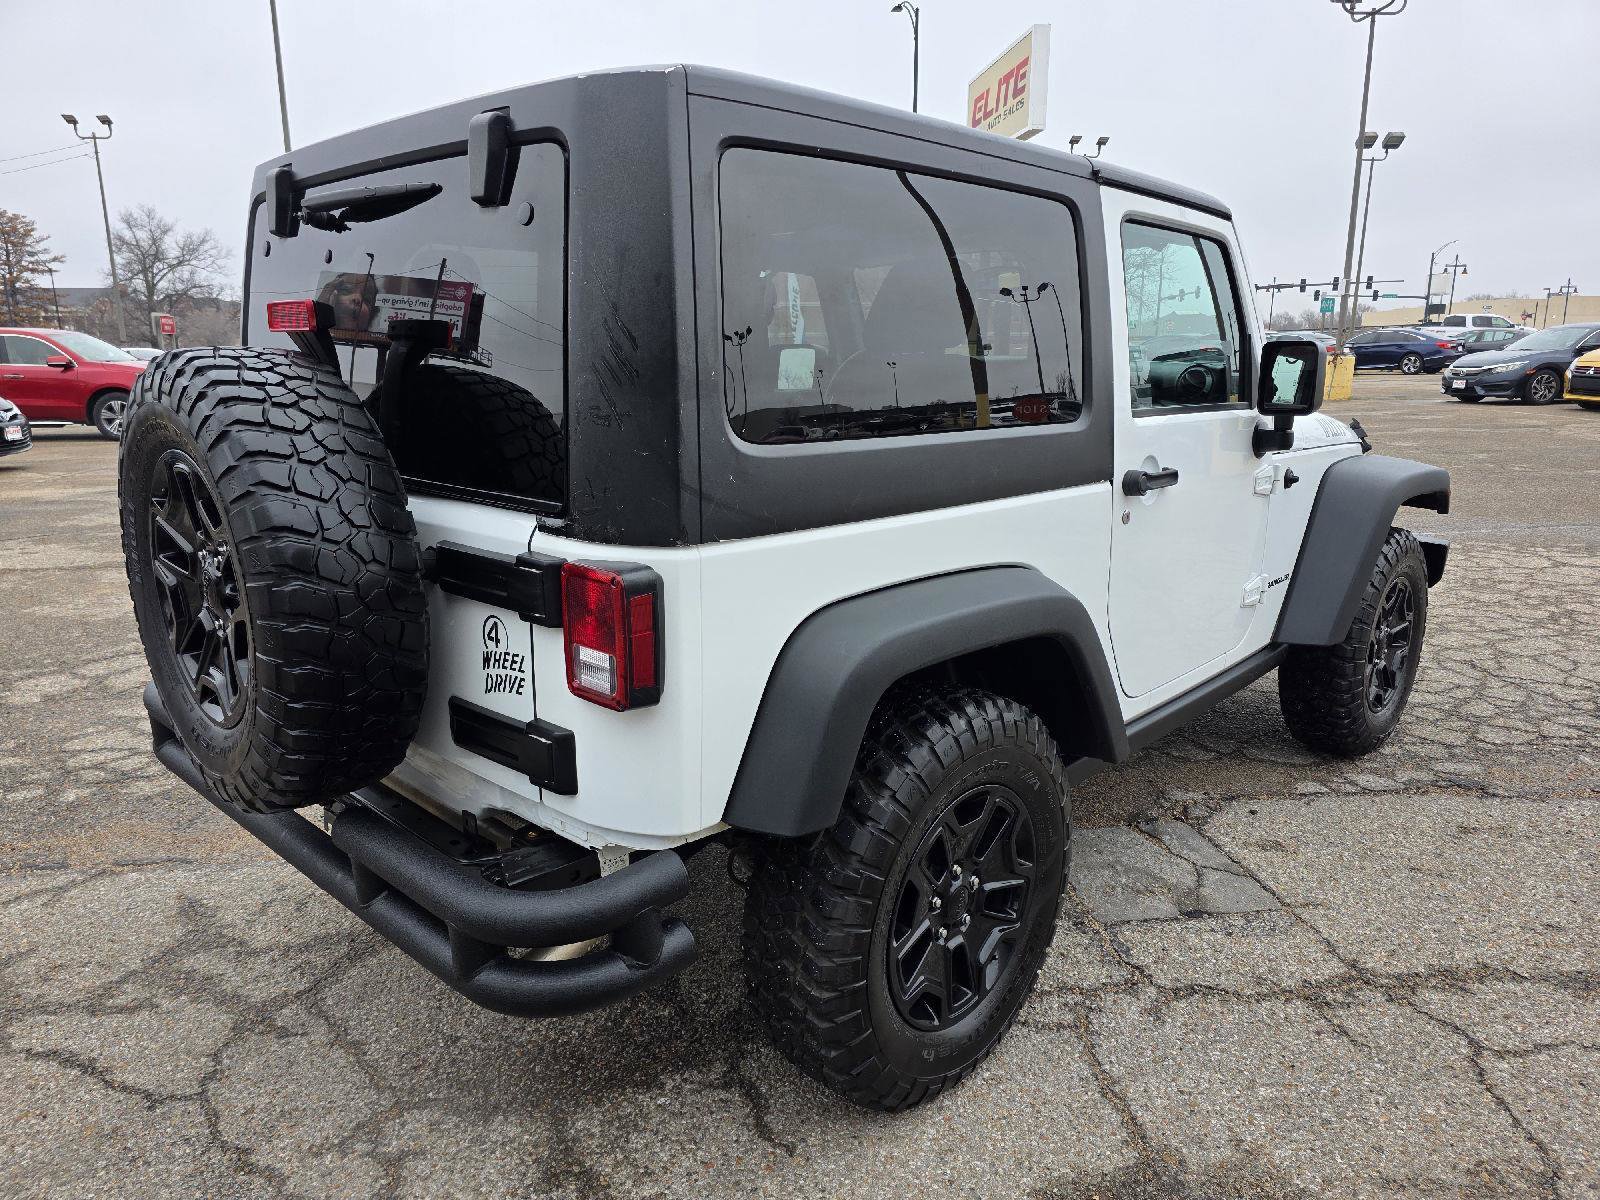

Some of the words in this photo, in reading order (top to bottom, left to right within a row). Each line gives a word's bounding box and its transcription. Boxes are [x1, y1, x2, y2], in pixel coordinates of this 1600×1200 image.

[972, 56, 1029, 128] ELITE
[987, 113, 1002, 131] AUTO
[1003, 98, 1024, 120] SALES
[487, 621, 500, 648] 4
[483, 651, 525, 673] WHEEL
[485, 673, 525, 695] DRIVE
